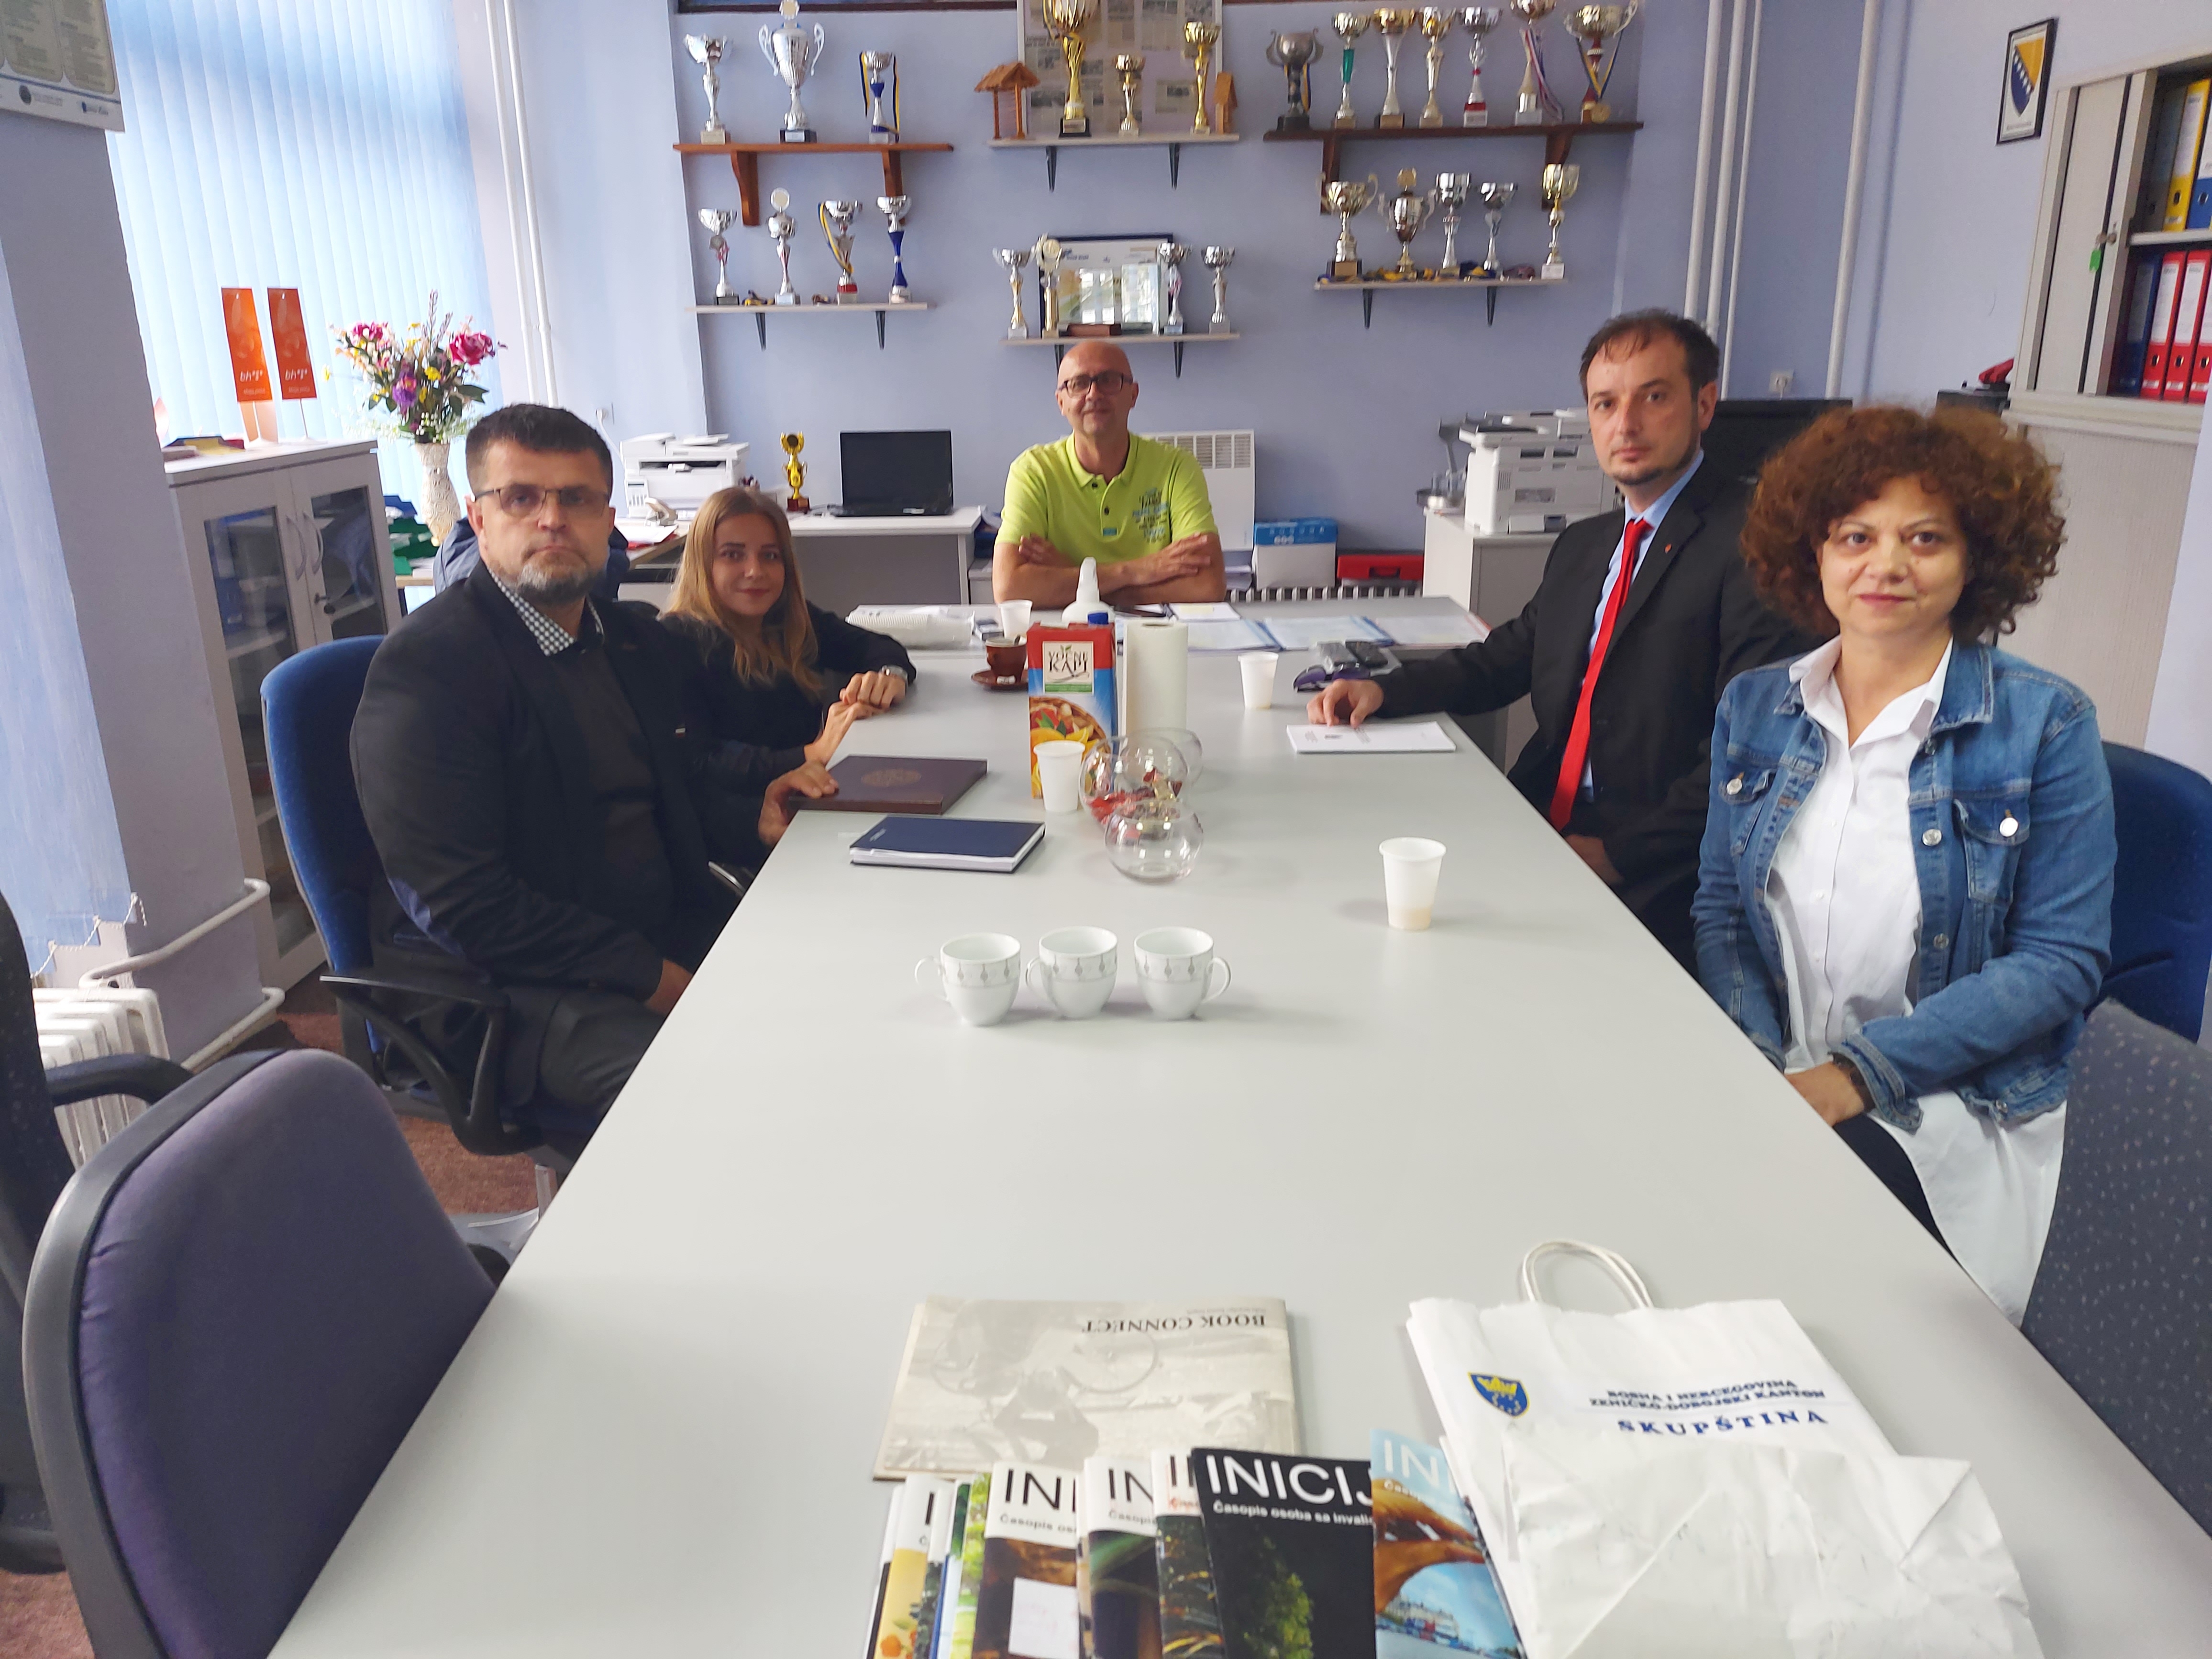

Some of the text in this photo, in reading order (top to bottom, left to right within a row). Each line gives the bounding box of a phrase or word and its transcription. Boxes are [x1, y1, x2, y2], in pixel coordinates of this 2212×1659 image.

[1083, 1314, 1266, 1334] BOOK CONNECT
[1617, 1409, 1829, 1435] SKUPŠTINA
[1213, 1499, 1268, 1518] Časopis
[1270, 1507, 1312, 1523] osoba
